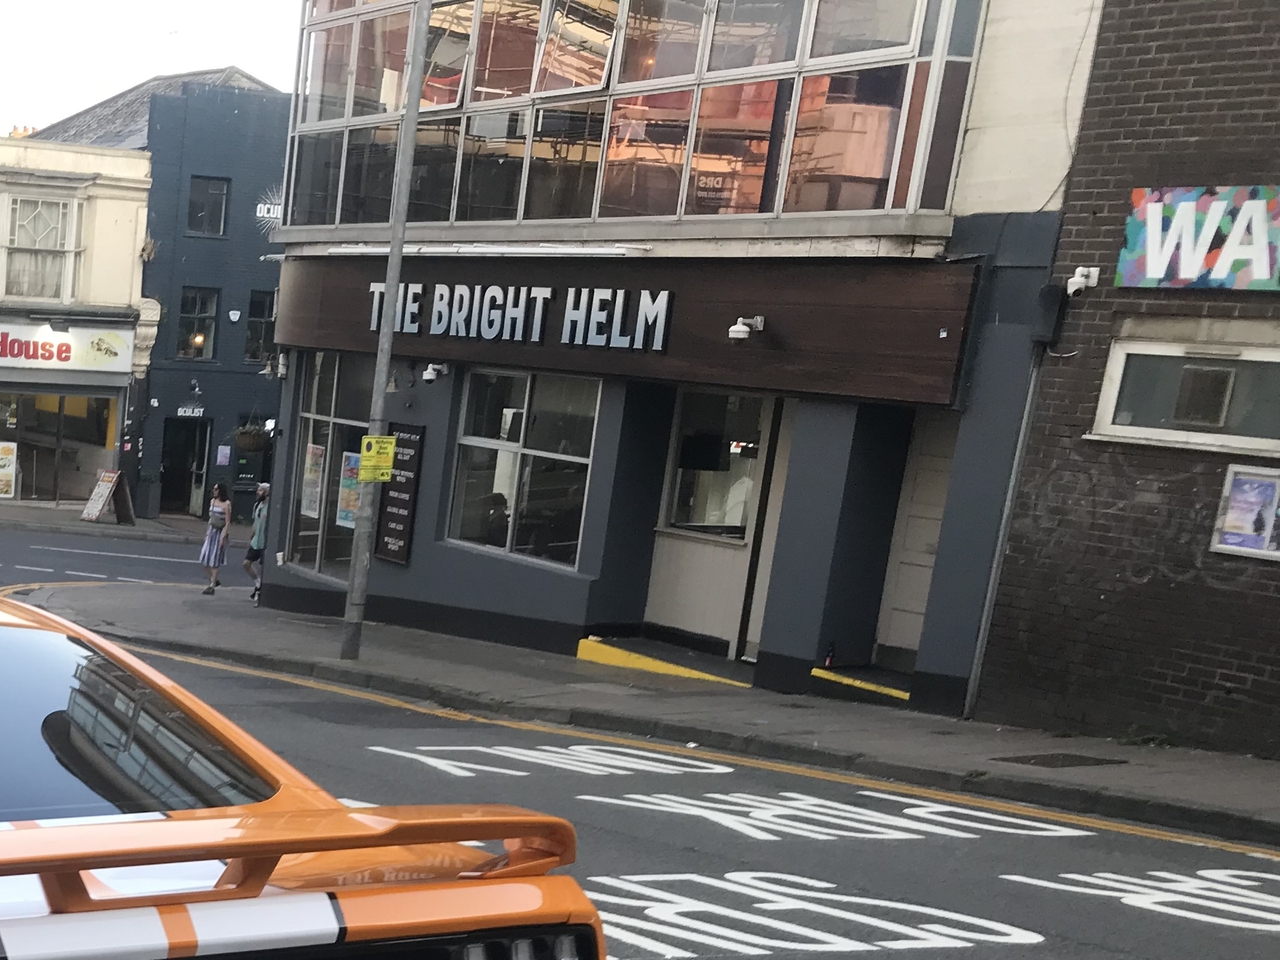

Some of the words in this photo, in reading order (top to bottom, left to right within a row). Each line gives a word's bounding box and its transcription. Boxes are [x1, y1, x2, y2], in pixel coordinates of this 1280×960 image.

[1146, 199, 1271, 280] WA
[429, 283, 553, 343] BRIGHT
[560, 287, 671, 352] HELM
[177, 407, 205, 417] OCULIST
[366, 745, 735, 777] ONLY
[575, 790, 1099, 840] PARK
[999, 868, 1280, 931] AR
